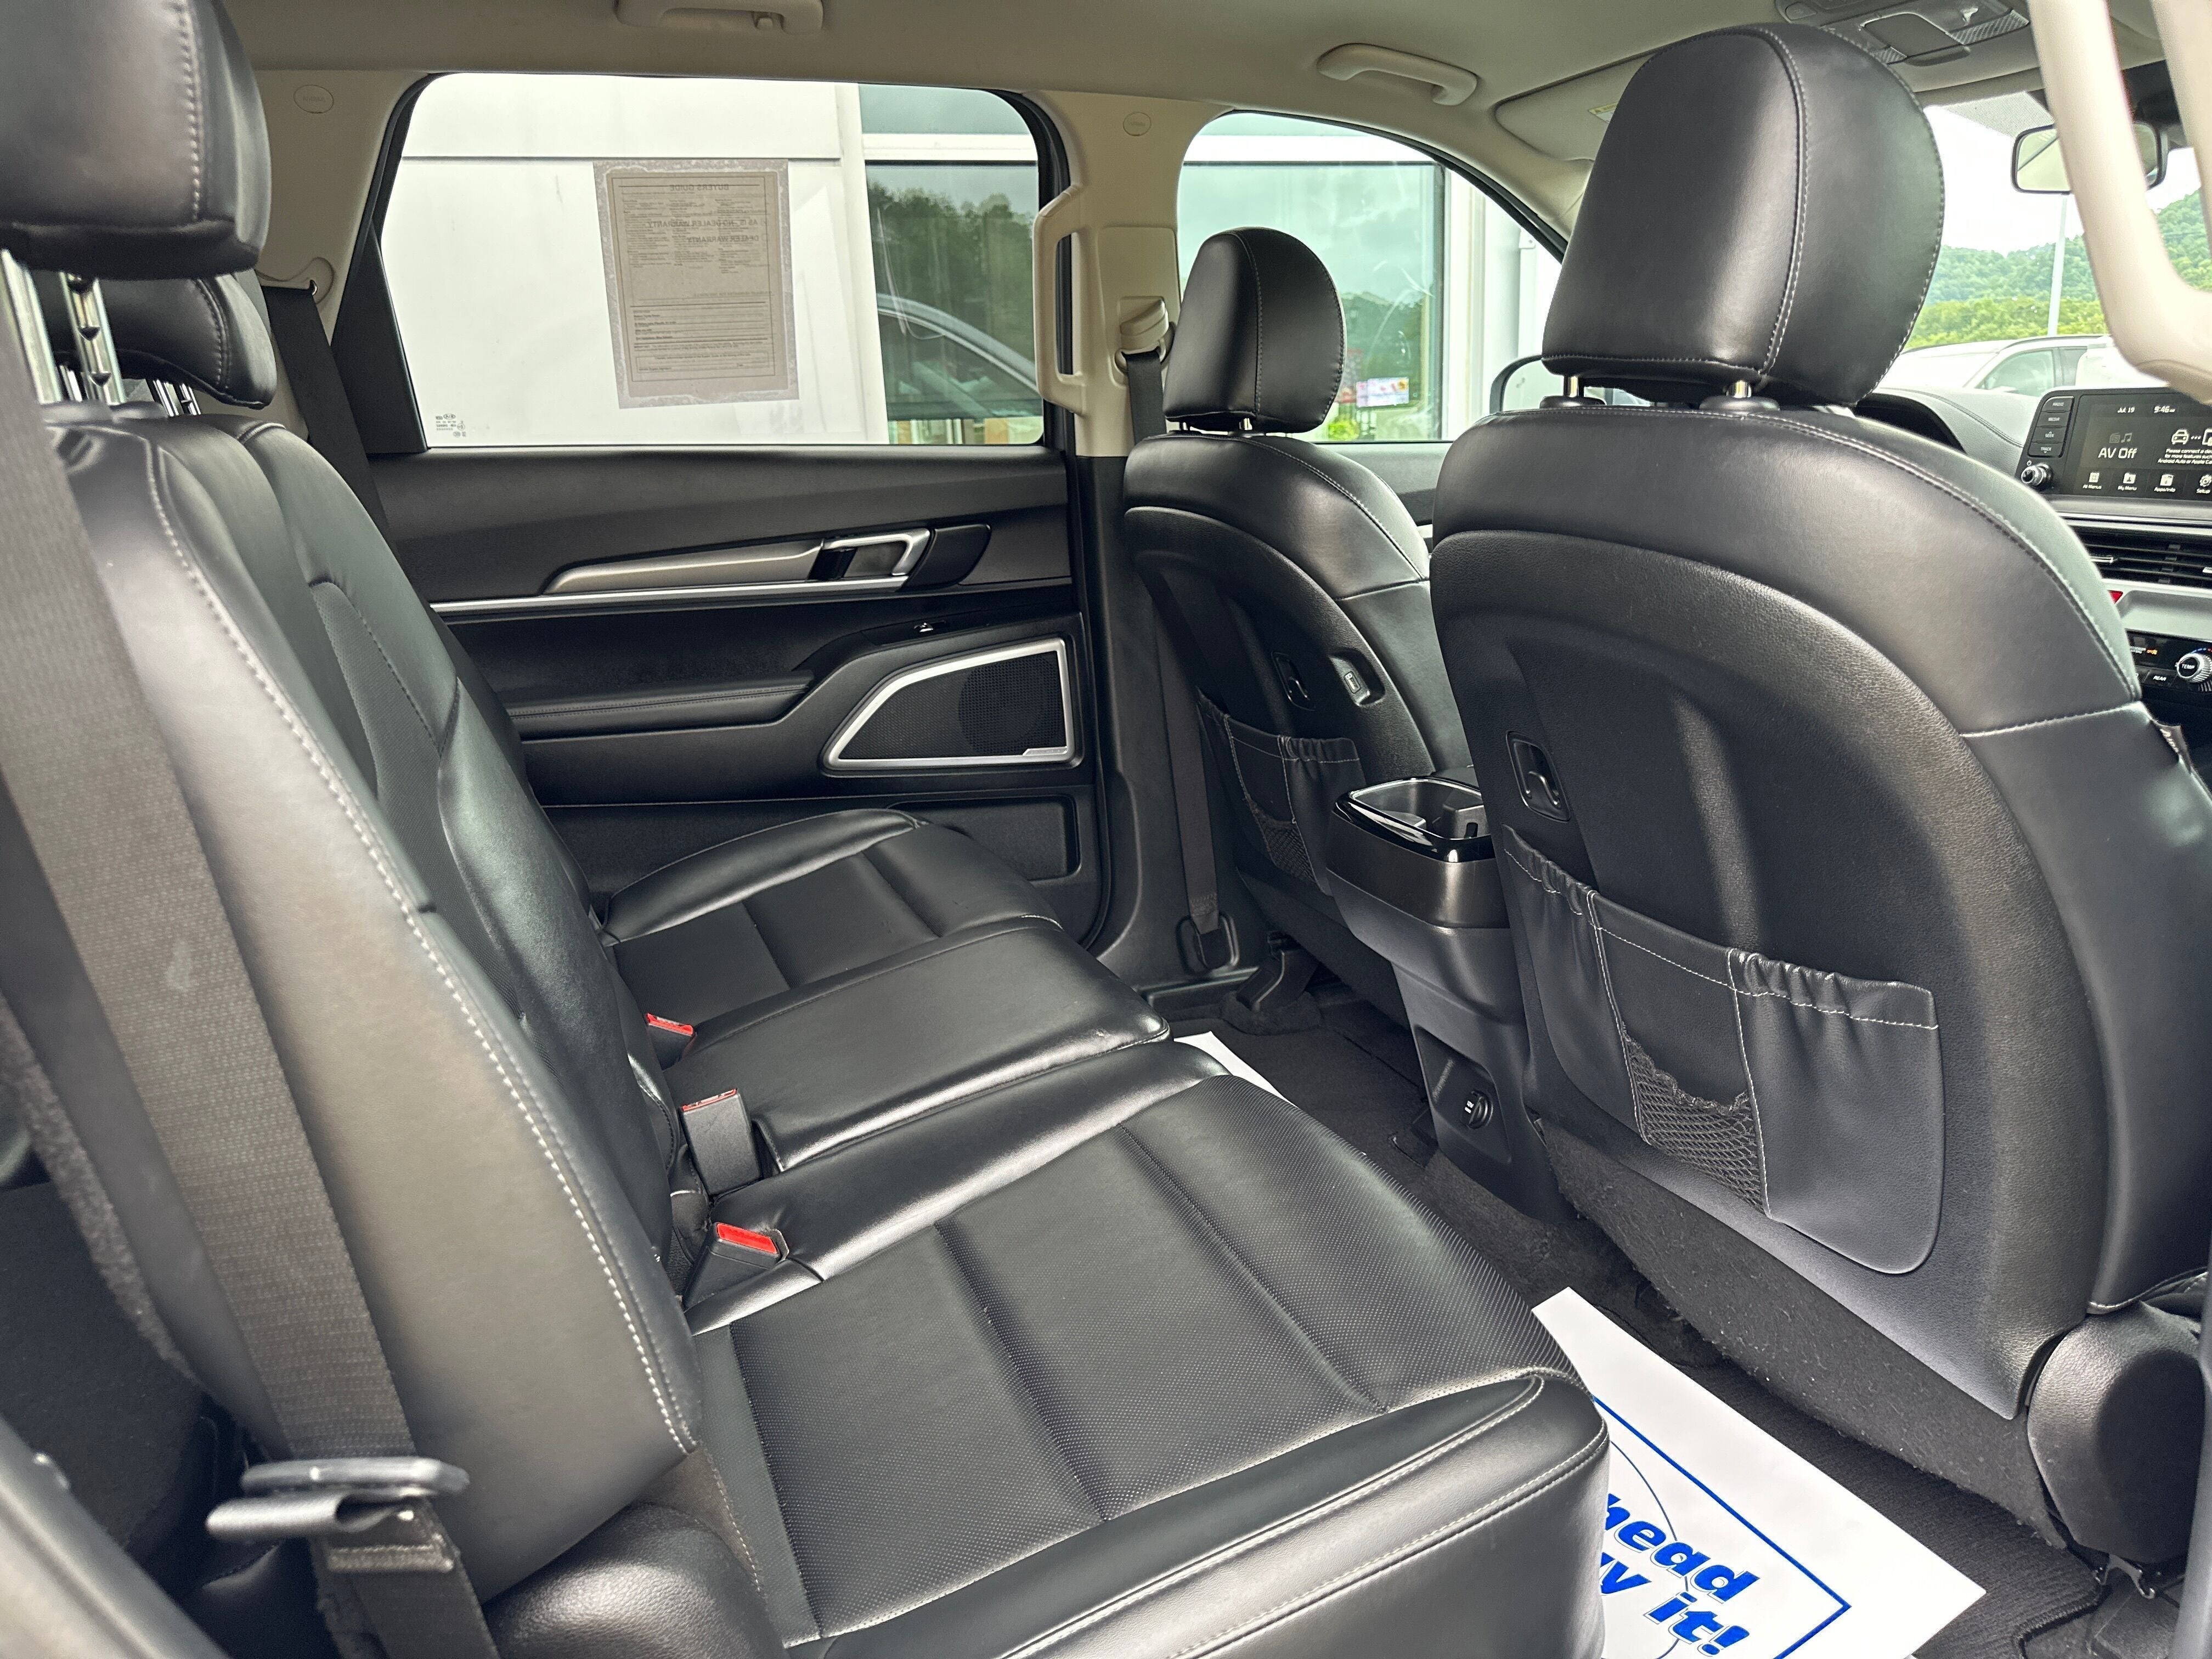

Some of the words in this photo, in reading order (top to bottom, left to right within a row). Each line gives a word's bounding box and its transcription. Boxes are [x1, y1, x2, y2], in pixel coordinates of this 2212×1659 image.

[2098, 448, 2117, 458] AV
[2118, 448, 2137, 459] Off
[1644, 1592, 1750, 1656] it!
